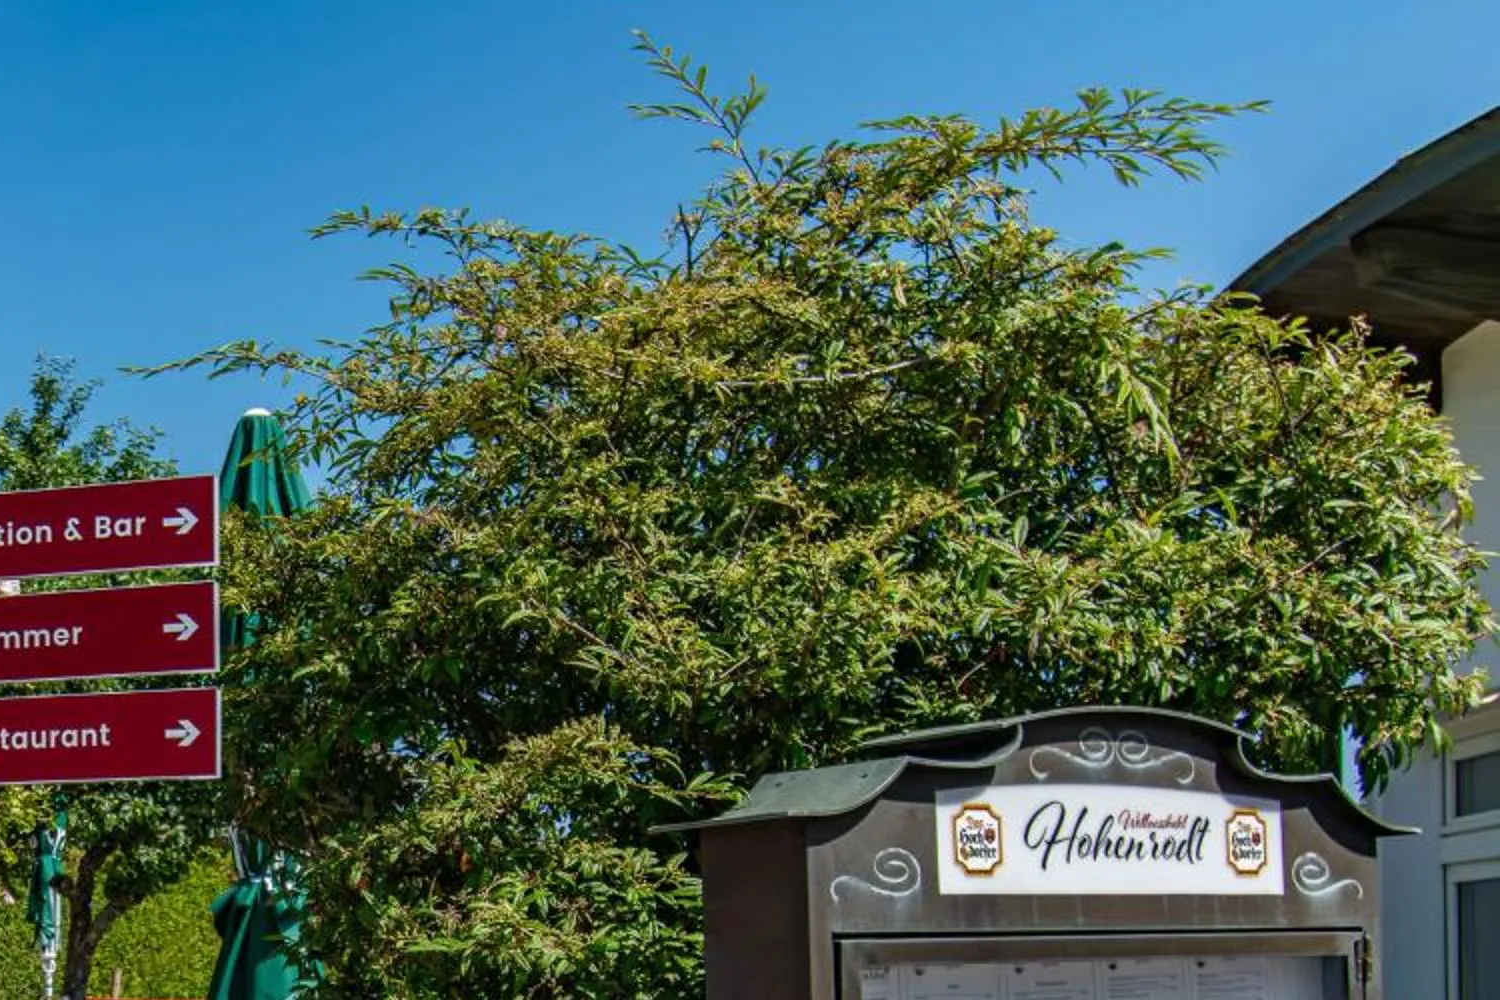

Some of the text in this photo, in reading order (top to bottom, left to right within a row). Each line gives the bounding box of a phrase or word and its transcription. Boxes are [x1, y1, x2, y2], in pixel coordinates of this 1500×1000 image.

[63, 517, 83, 541] &
[95, 515, 147, 539] Bar
[1023, 800, 1211, 871] Hohenrodt
